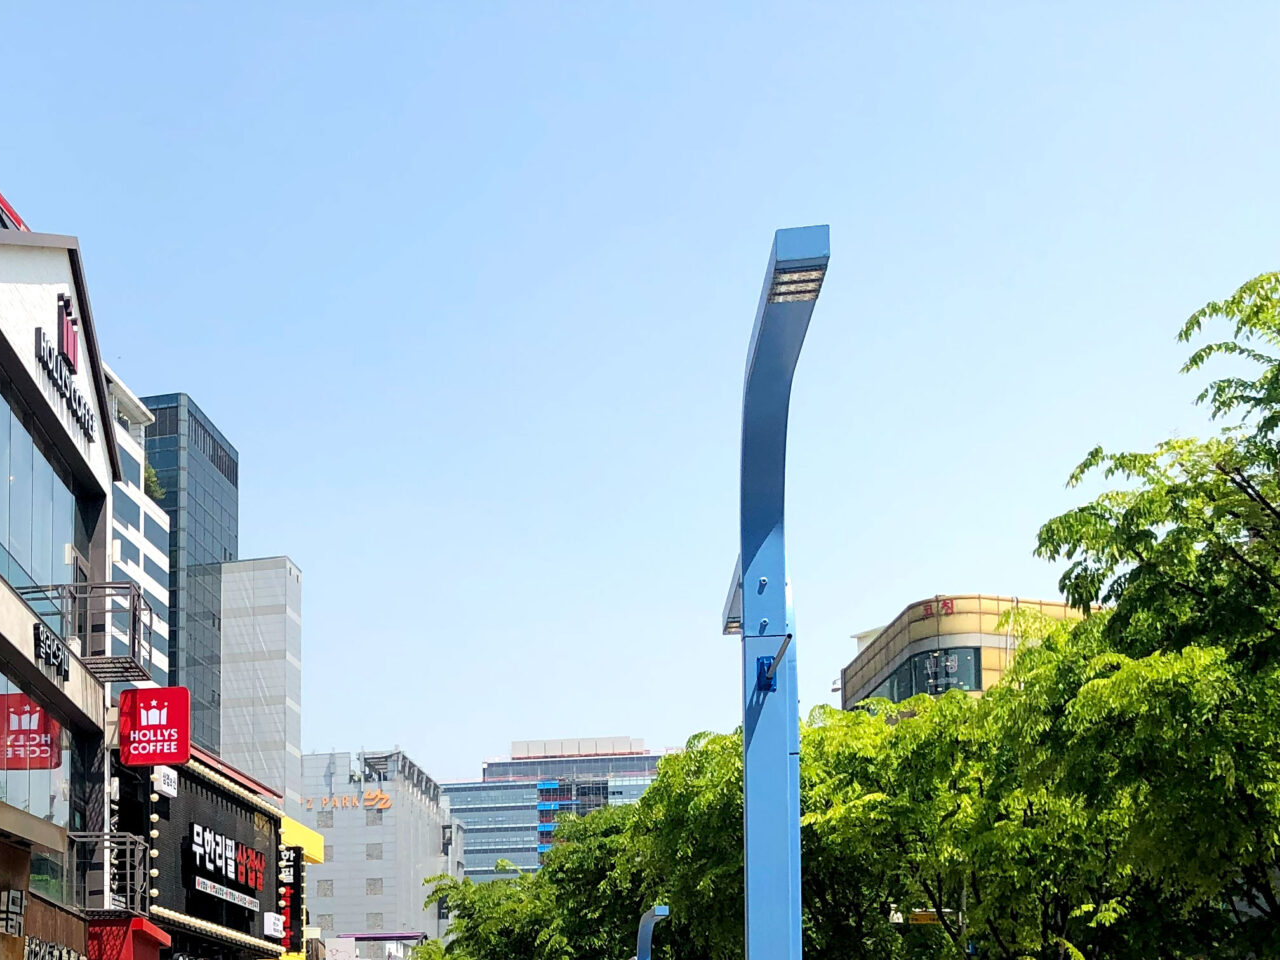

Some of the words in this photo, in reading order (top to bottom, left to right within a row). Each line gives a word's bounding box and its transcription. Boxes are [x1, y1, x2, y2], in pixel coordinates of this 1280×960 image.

[41, 331, 70, 399] HOLLYS
[70, 380, 96, 441] COFFEE
[130, 729, 178, 741] HOLLYS
[130, 743, 178, 754] COFFEE
[321, 795, 358, 808] PARK
[192, 823, 235, 880] 무한리필
[236, 843, 266, 892] 삼겹살
